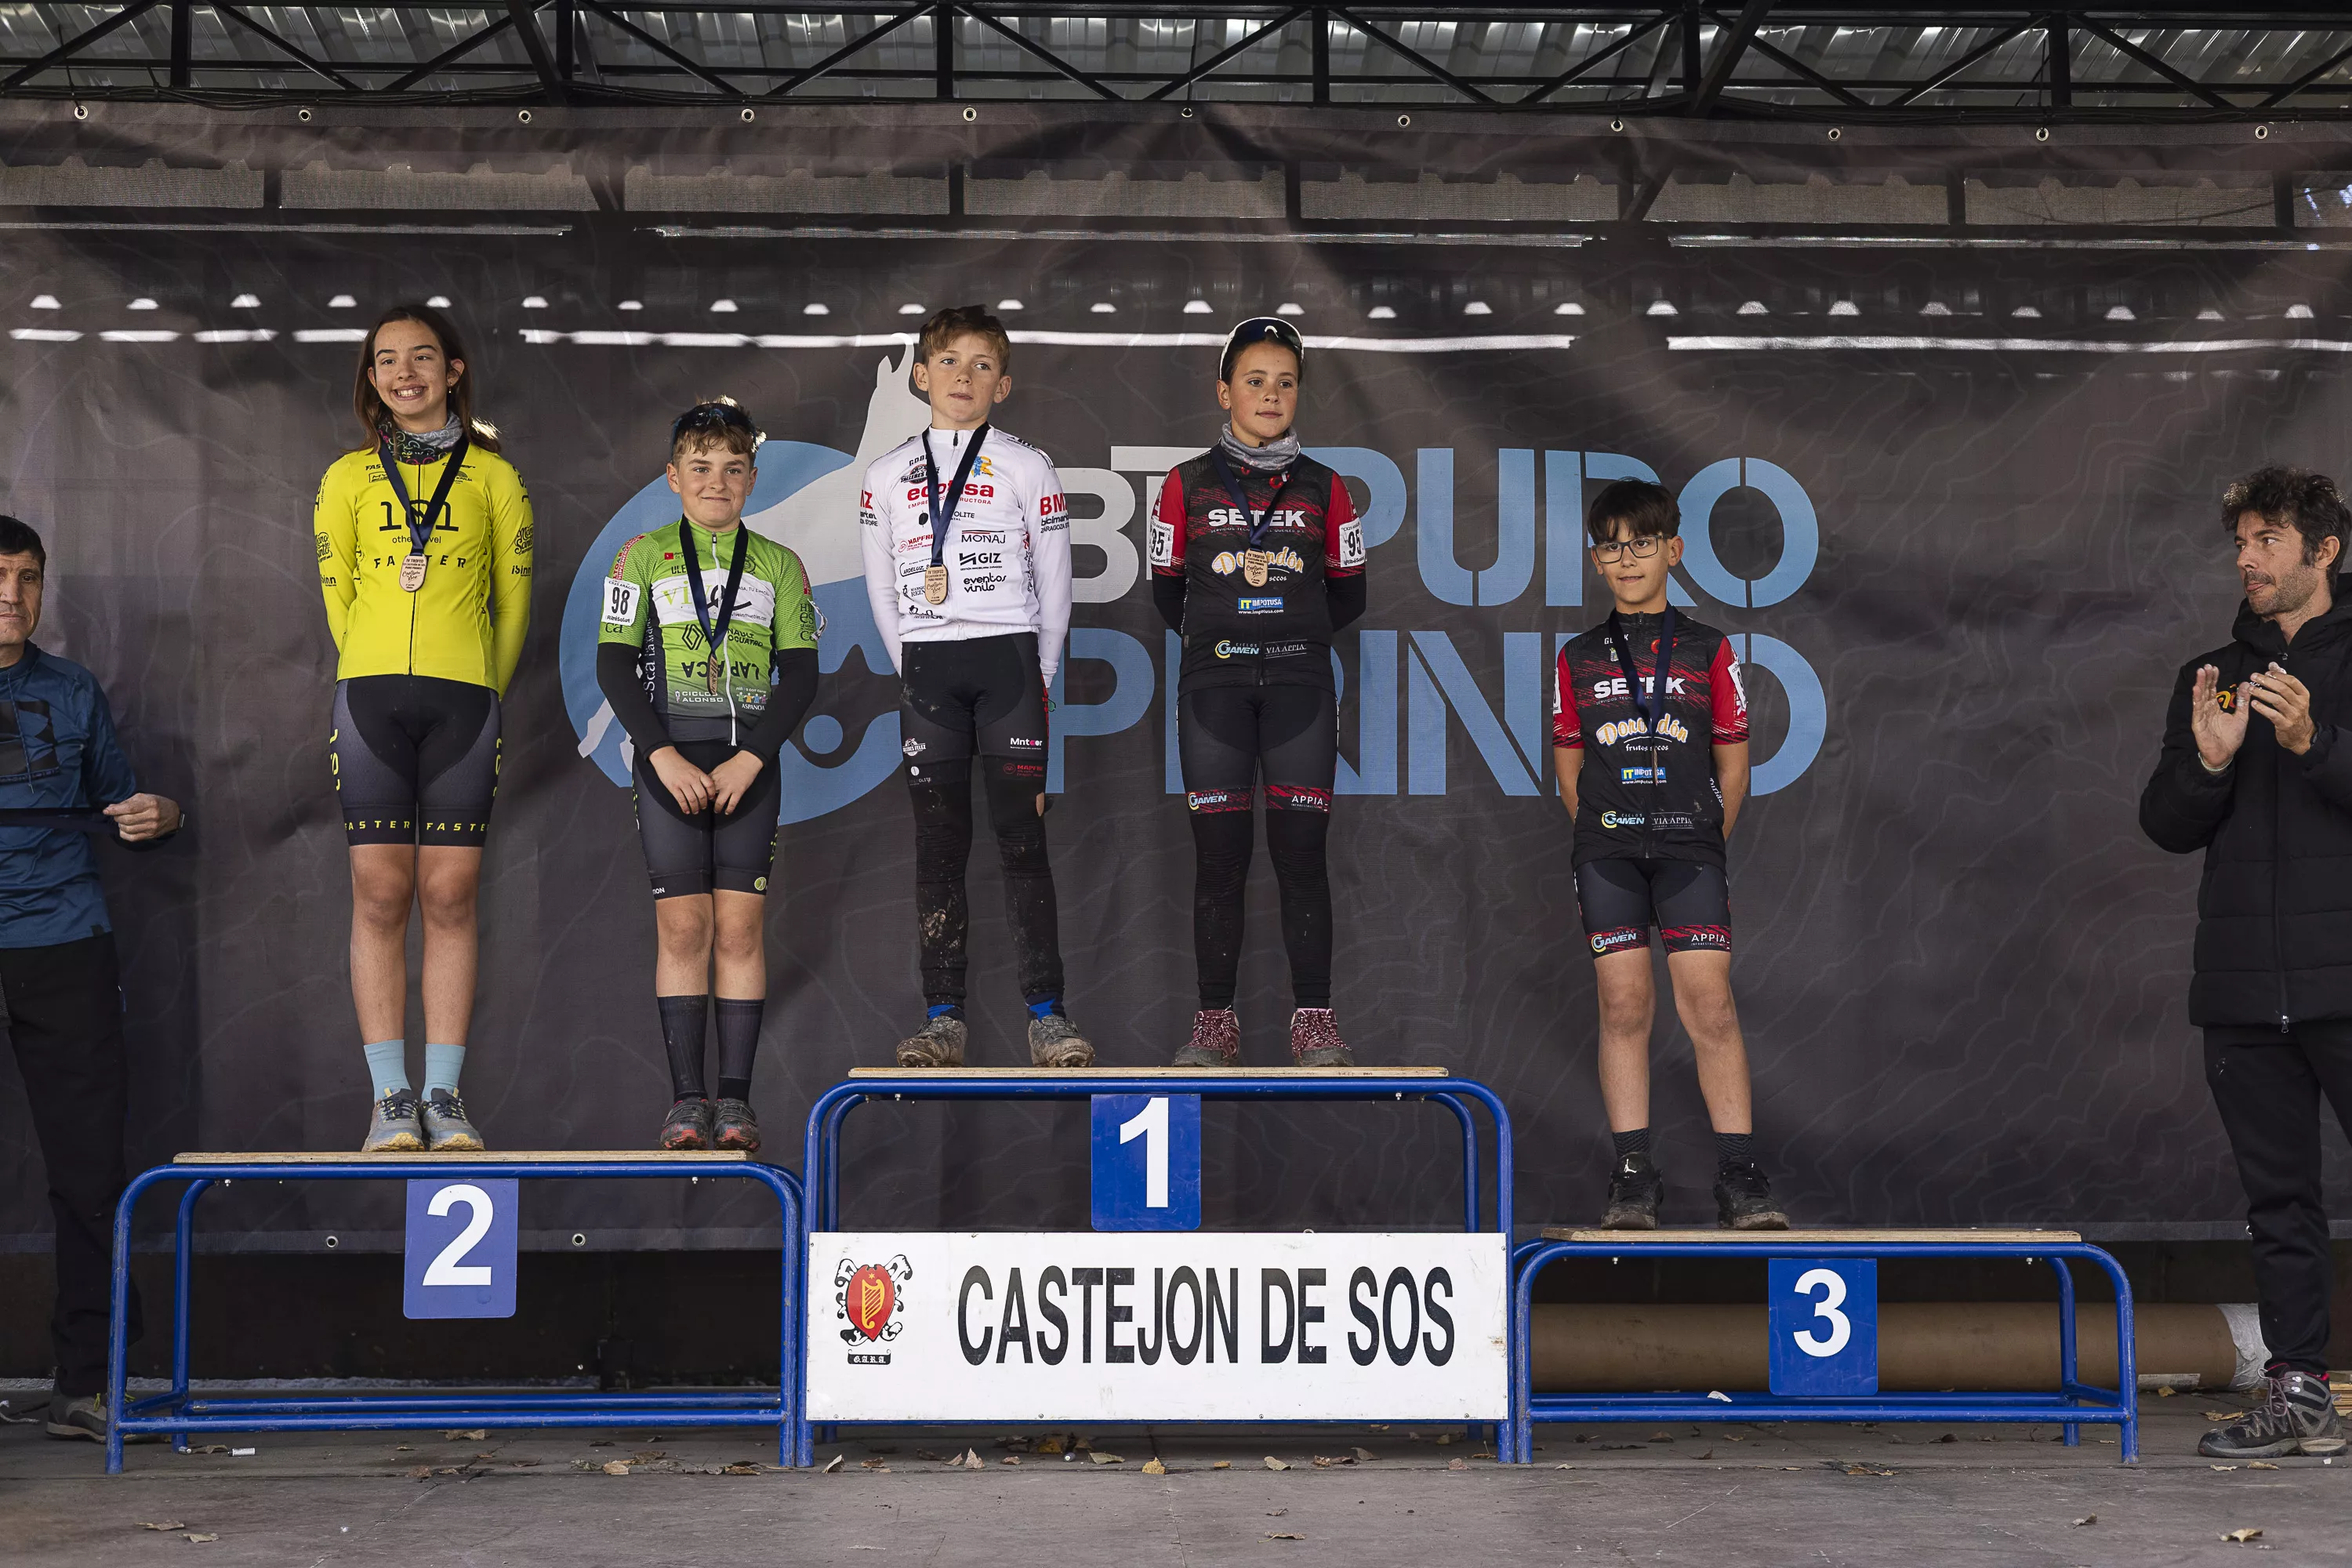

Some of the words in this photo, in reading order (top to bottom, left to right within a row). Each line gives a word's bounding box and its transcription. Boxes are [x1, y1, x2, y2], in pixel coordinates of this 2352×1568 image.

[1040, 492, 1068, 516] BM
[1208, 508, 1306, 528] SETEK
[961, 535, 1006, 544] MONAJ
[1348, 528, 1362, 557] 95
[373, 554, 466, 569] FATER
[978, 553, 1002, 564] GIZ
[612, 587, 630, 615] 98
[1291, 795, 1323, 805] APPIA
[1691, 934, 1726, 943] APPIA
[1120, 1098, 1169, 1208] 1
[422, 1184, 494, 1286] 2
[958, 1265, 1239, 1366] CASTEJON
[1261, 1267, 1327, 1364] DE
[1348, 1265, 1455, 1367] SOS
[1793, 1268, 1851, 1358] 3
